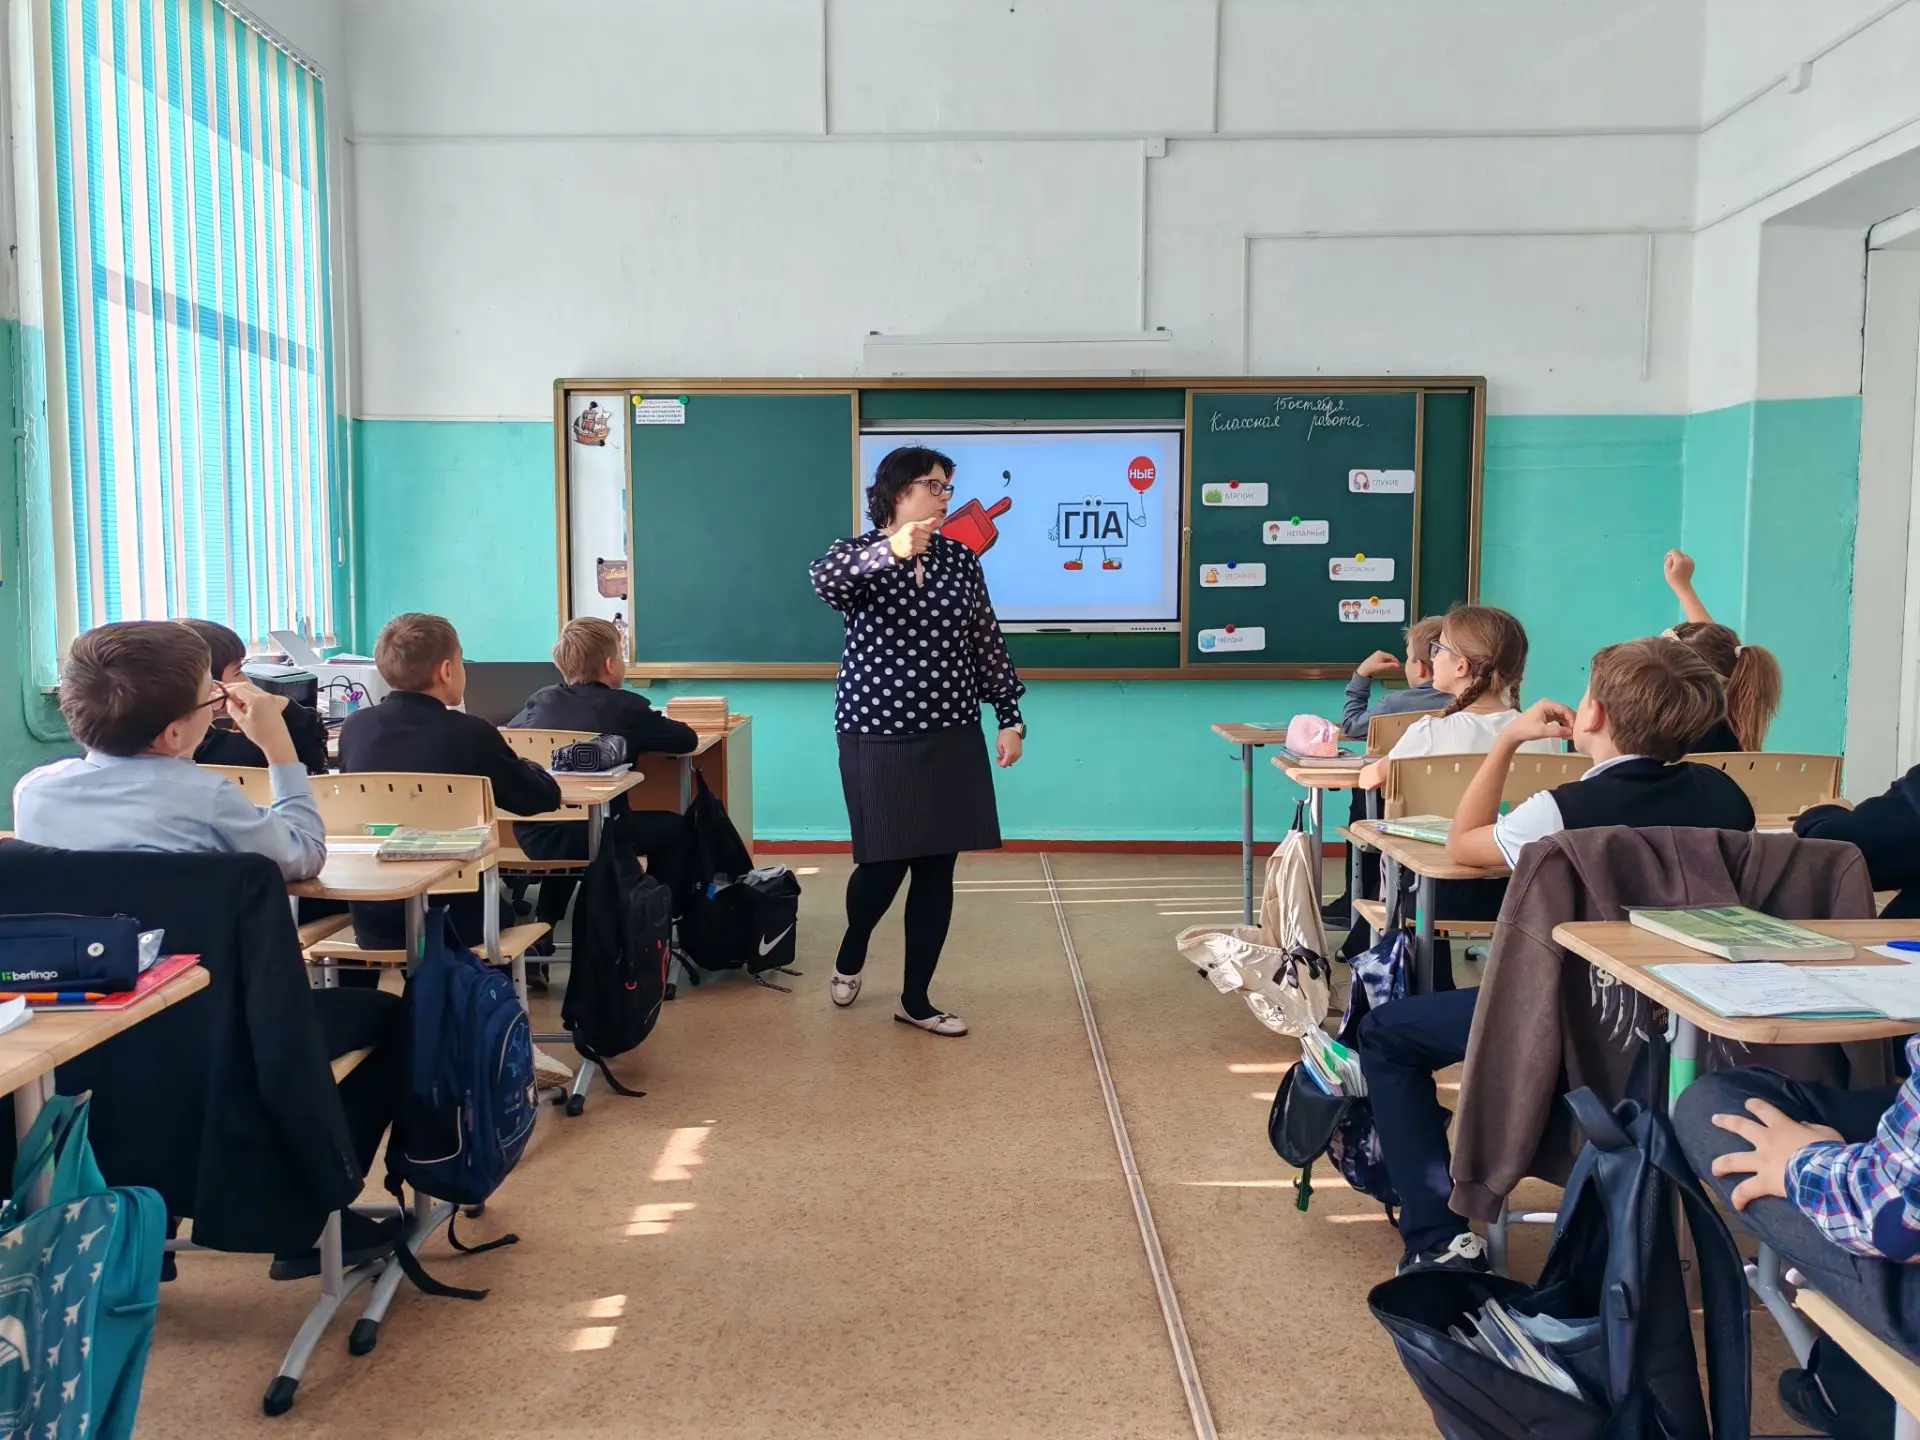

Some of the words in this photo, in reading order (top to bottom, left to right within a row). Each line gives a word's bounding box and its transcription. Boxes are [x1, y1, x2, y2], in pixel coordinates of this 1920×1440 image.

[1209, 410, 1281, 432] Классная
[1129, 468, 1154, 479] НЫЕ
[1372, 479, 1399, 487] ГЛУХИЕ
[1225, 492, 1255, 500] МЯГКИЕ
[1064, 510, 1124, 539] ГЛА
[1286, 529, 1326, 537] НЕПАРНЫЕ
[13, 970, 58, 981] berlingo
